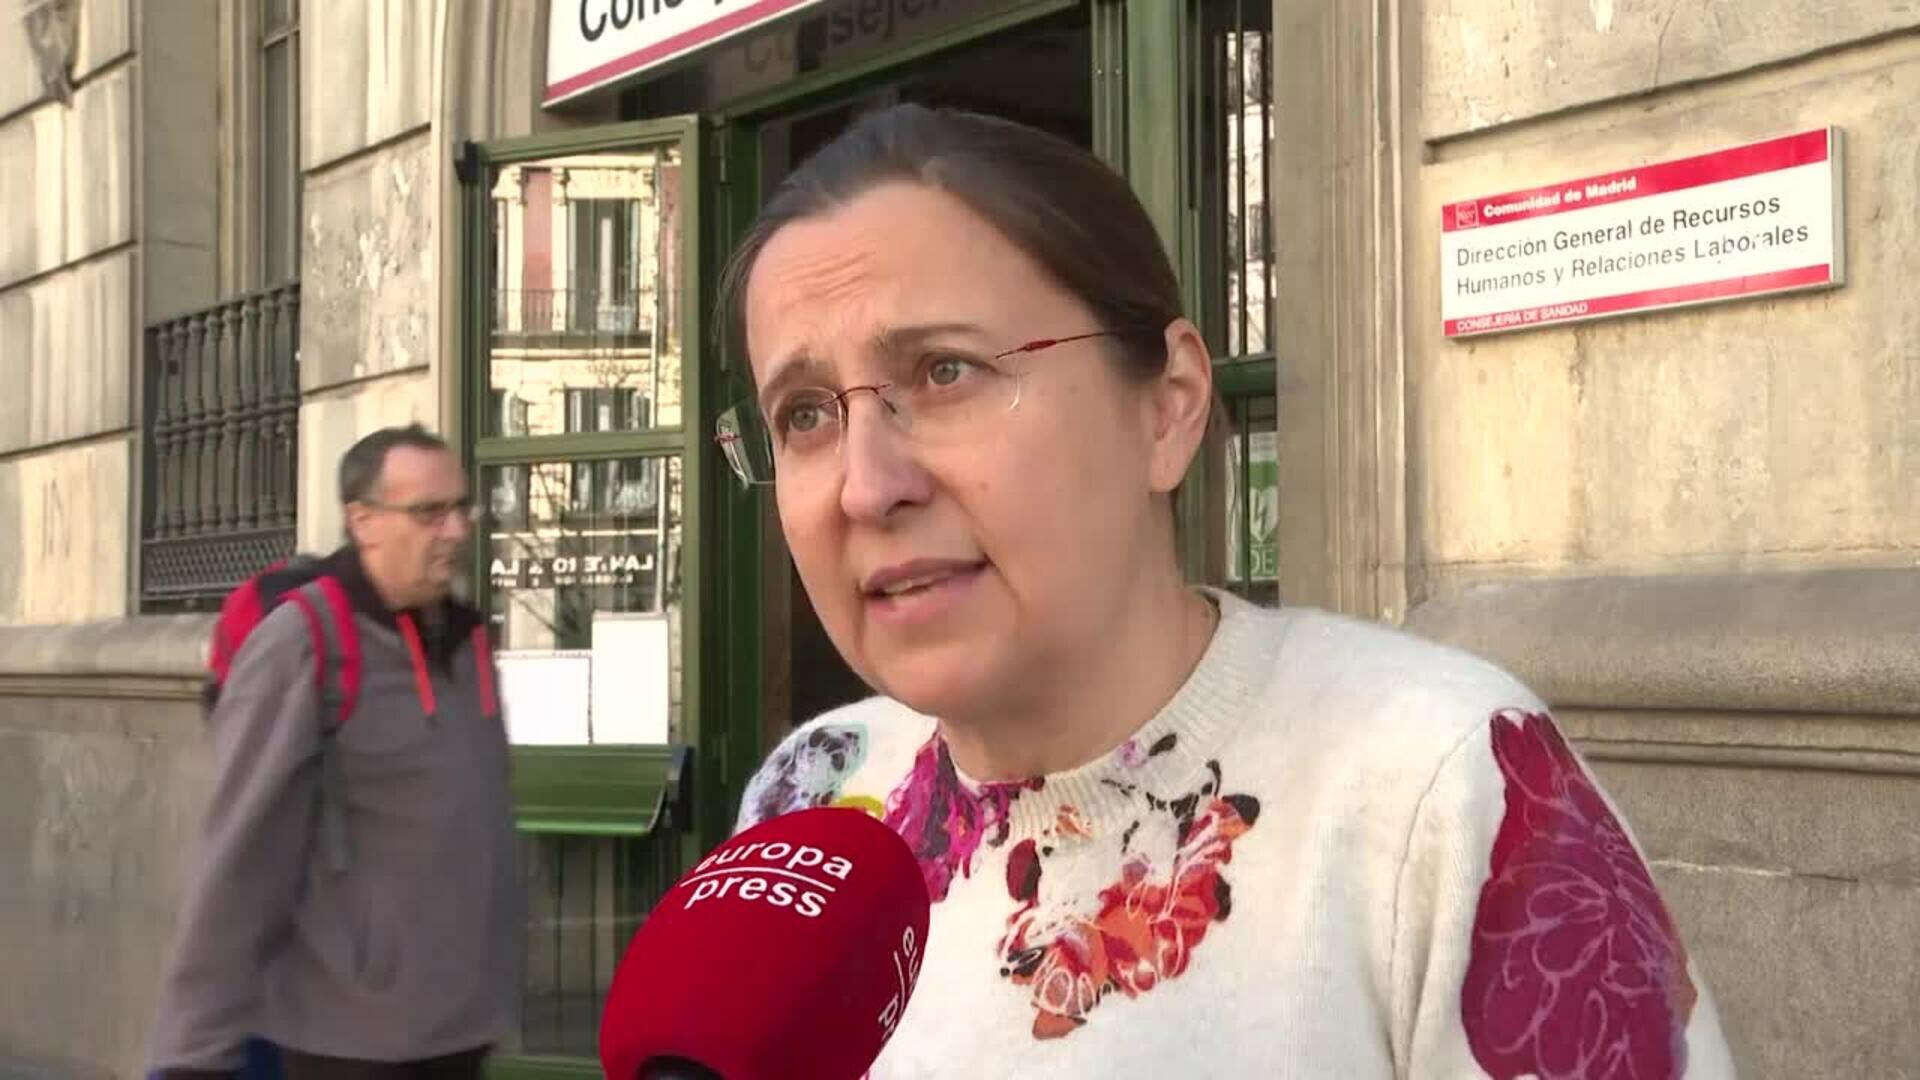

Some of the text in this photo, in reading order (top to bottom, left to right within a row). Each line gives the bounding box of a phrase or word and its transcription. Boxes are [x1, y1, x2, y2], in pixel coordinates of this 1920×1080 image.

[1483, 176, 1637, 218] Comunidad de Madrid
[1457, 196, 1781, 267] Dirección General de Recursos
[1457, 224, 1809, 296] Humanos y Relaciones Laborales
[1523, 309, 1539, 322] DE
[1540, 301, 1589, 320] SANIDAD
[695, 841, 853, 881] europa
[683, 876, 827, 918] press
